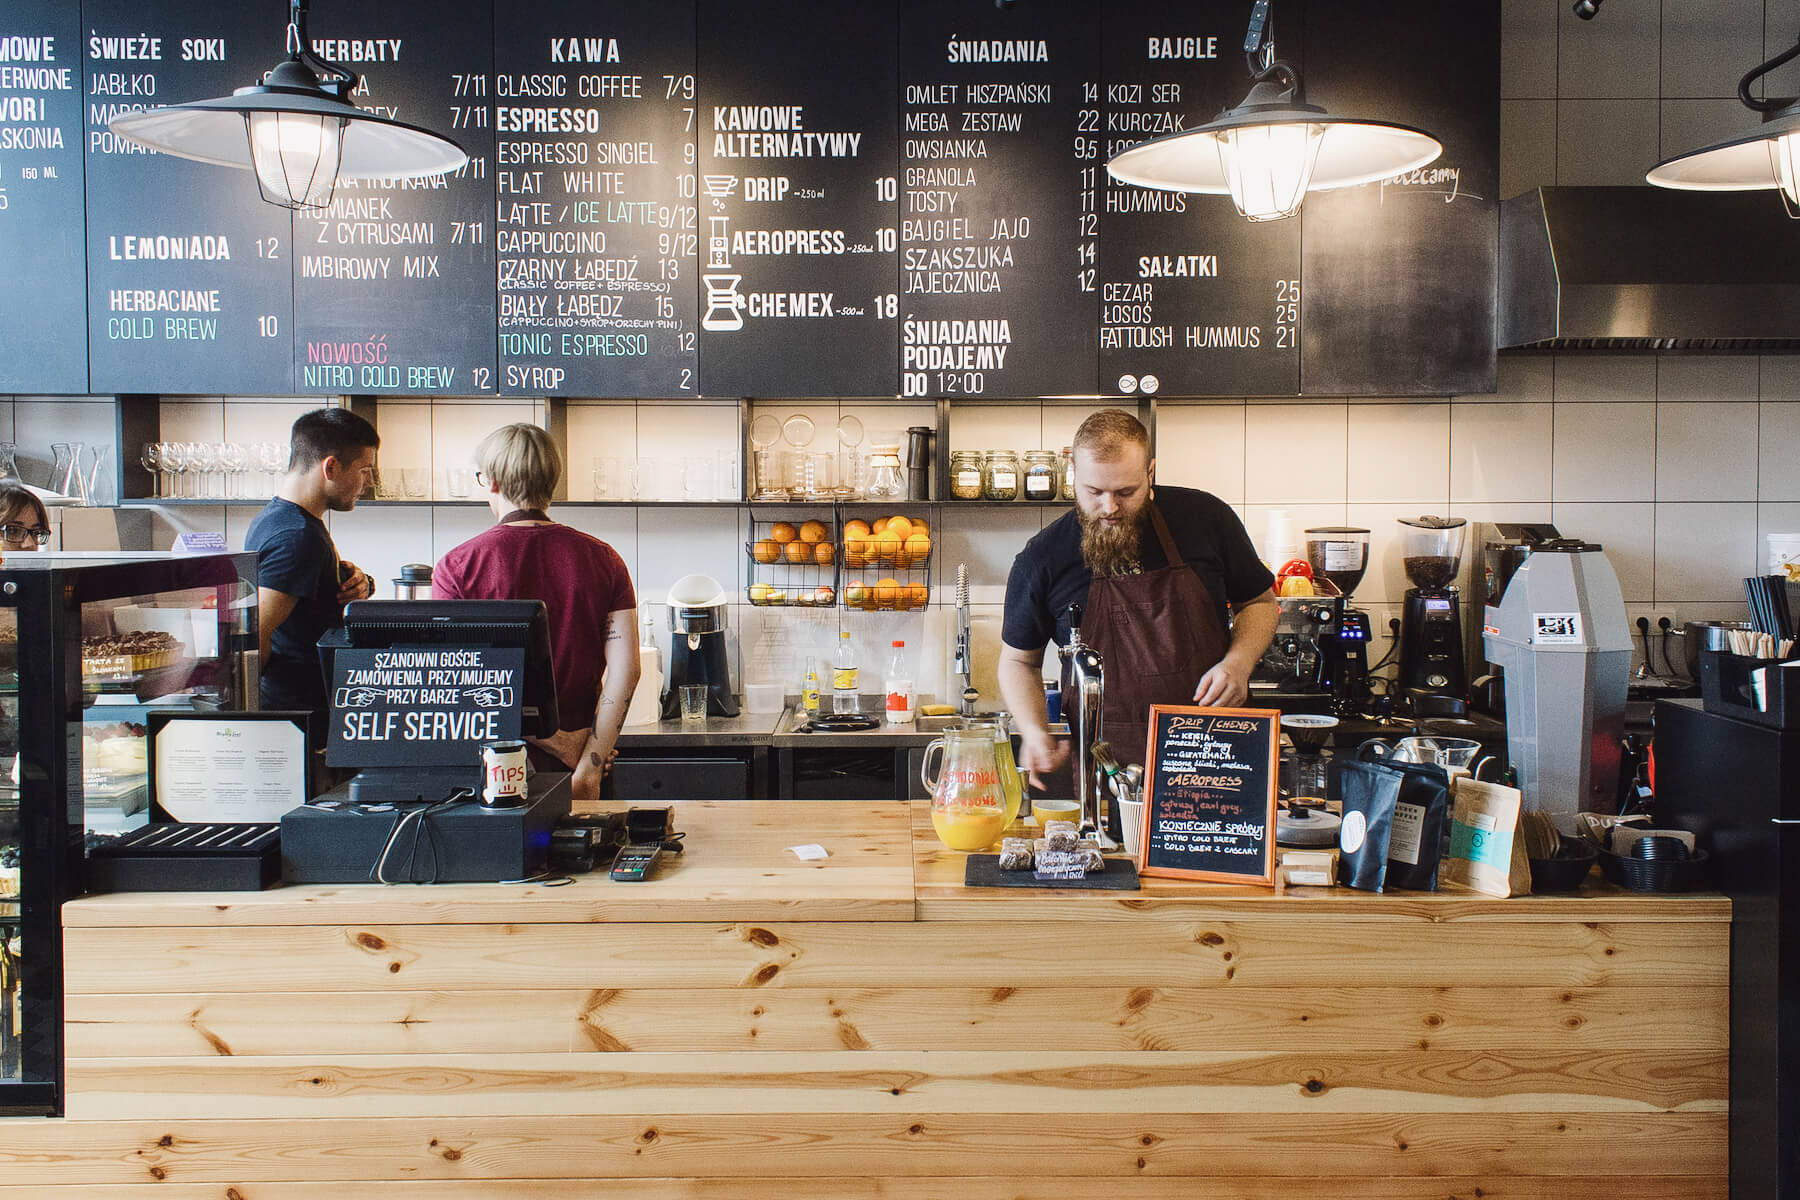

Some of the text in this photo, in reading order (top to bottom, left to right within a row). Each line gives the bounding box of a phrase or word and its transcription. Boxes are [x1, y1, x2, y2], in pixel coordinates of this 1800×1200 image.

[90, 29, 226, 61] ŚWIEŻE SOKI
[551, 38, 621, 63] KAWA
[947, 33, 1049, 63] ŚNIADANIA
[1148, 37, 1218, 59] BAJGLE
[0, 66, 72, 90] ERWONE
[90, 73, 156, 96] JABŁKO
[451, 74, 486, 97] 7/11
[496, 74, 695, 100] CLASSIC COFFEE 7/9
[906, 81, 1099, 104] OMLET HISZPAŃSKI 14
[1107, 83, 1182, 104] KOZI SER
[450, 106, 488, 128] 7/11
[496, 107, 694, 133] ESPRESSO 7
[713, 106, 803, 131] KAWOWE
[905, 109, 1100, 132] MEGA ZESTAW 22
[1107, 112, 1186, 132] KURCZAK
[0, 127, 64, 149] SKONIA
[713, 132, 861, 158] ALTERNATYWY
[906, 139, 988, 159] OWSIANKA
[498, 141, 695, 165] ESPRESSO SINGIEL 9
[44, 166, 58, 179] ML
[498, 171, 696, 198] FLAT WHITE 10
[906, 167, 977, 187] GRANOLA
[1080, 167, 1096, 190] 11
[744, 177, 790, 201] DRIP
[875, 177, 897, 201] 10
[299, 197, 393, 219] RUMIANEK
[907, 190, 1095, 214] TOSTY 11
[1106, 190, 1187, 213] HUMMUS
[497, 201, 552, 227] LATTE
[573, 201, 600, 224] ICE
[607, 201, 657, 225] LATTE
[658, 205, 697, 230] 9/12
[902, 213, 1098, 242] BAJGIEL JAJO 12
[317, 222, 482, 245] Z CYTRUSAMI 7/11
[497, 231, 697, 258] CAPPUCCINO 9/12
[732, 230, 845, 255] AEROPRESS
[875, 228, 897, 253] 10
[110, 235, 279, 260] LEMONIADA 12
[904, 242, 1097, 271] SZAKSZUKA 14
[302, 256, 440, 279] IMBIROWY MIX
[498, 259, 566, 282] CZARNY
[658, 258, 679, 280] 13
[1138, 255, 1218, 278] SAŁATKI
[905, 268, 1096, 294] JAJECZNICA 12
[1103, 280, 1300, 302] CEZAR 25
[110, 290, 221, 312] HERBACIANE
[501, 295, 548, 317] BIAŁY
[656, 295, 674, 319] 15
[748, 292, 834, 318] CHEMEX
[874, 293, 899, 319] 18
[1103, 300, 1298, 324] ŁOSOŚ 25
[108, 315, 278, 340] COLD BREW 10
[903, 313, 1012, 345] ŚNIADANIA
[1100, 326, 1296, 348] FATTOUSH HUMMUS 21
[307, 334, 388, 364] NOWOŚĆ
[500, 332, 695, 356] TONIC ESPRESSO 12
[903, 345, 1008, 370] PODAJEMY
[304, 365, 491, 389] NITRO COLD BREW 12
[507, 365, 692, 390] SYROP 2
[903, 372, 928, 397] DO
[374, 650, 484, 669] SZANOWNI GOŚCIE,
[347, 668, 514, 686] ZAMÓWIENIA PRZYJMUJEMY
[386, 689, 460, 705] PRZY BARZE
[343, 711, 500, 741] SELF SERVICE
[491, 766, 525, 782] TIPS
